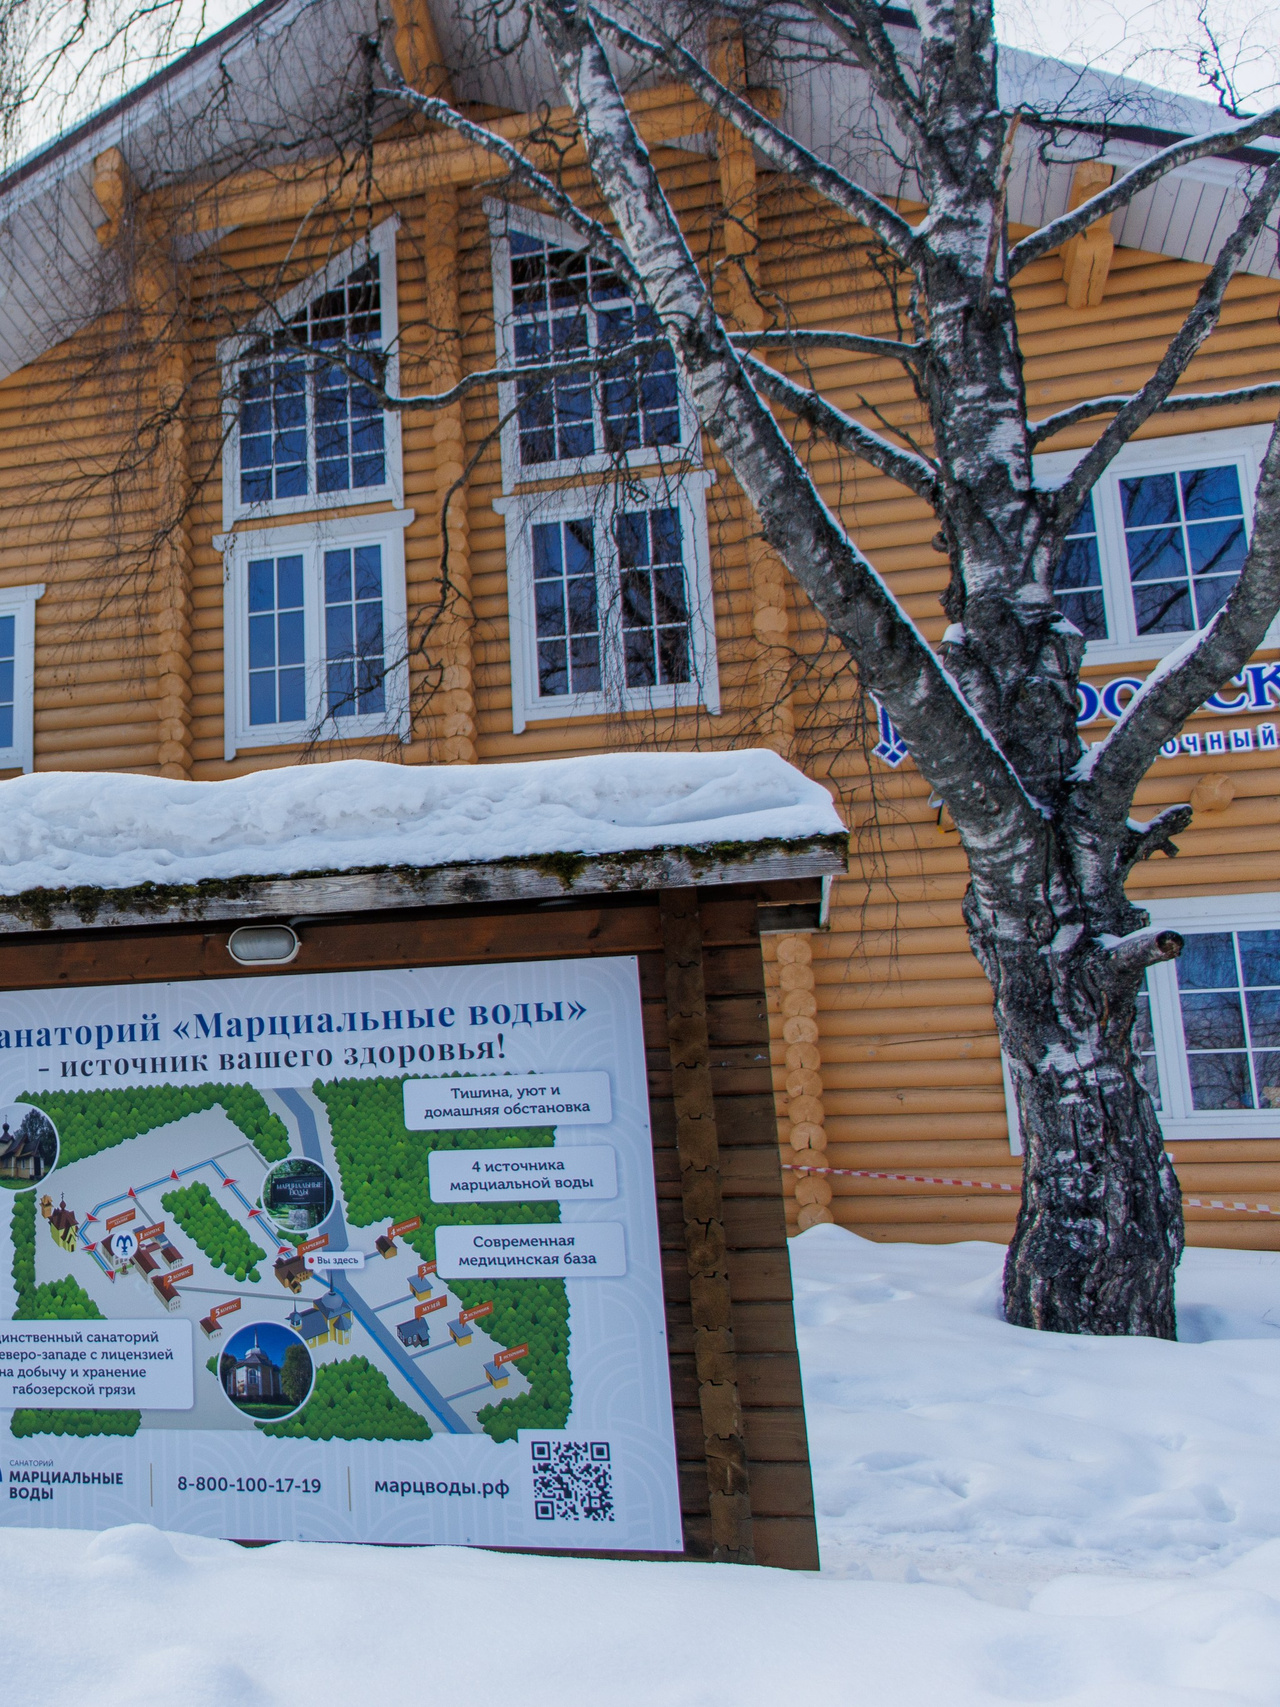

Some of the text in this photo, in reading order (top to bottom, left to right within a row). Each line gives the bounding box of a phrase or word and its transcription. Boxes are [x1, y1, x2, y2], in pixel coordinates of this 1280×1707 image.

[172, 1005, 456, 1043] «Марциальные
[469, 1000, 588, 1029] воды»
[60, 1053, 209, 1078] источник
[219, 1046, 332, 1072] вашего
[343, 1033, 506, 1068] здоровья!
[450, 1085, 561, 1099] Тишина, уют и
[424, 1102, 590, 1119] домашняя обстановка
[471, 1160, 565, 1173] 4 источника
[449, 1177, 594, 1193] марциальной воды
[139, 1232, 144, 1240] 1
[390, 1228, 396, 1236] 4
[472, 1235, 575, 1250] Современная
[317, 1256, 359, 1265] Вы здесь
[458, 1252, 597, 1268] медицинская база
[421, 1266, 427, 1274] 3
[166, 1275, 173, 1283] 2
[215, 1308, 220, 1316] 5
[86, 1331, 159, 1345] санаторий
[90, 1351, 98, 1360] с
[101, 1348, 174, 1362] лицензией
[17, 1366, 67, 1380] добычу
[70, 1368, 79, 1377] и
[82, 1368, 147, 1380] хранение
[12, 1383, 136, 1397] габозерской грязи
[9, 1459, 54, 1467] САНАТОРИЙ
[9, 1470, 124, 1486] МАРЦИАЛЬНЫЕ
[177, 1475, 322, 1494] 8-800-100-17-19
[9, 1487, 54, 1501] ВОДЫ
[374, 1478, 510, 1499] марцводы.рф
